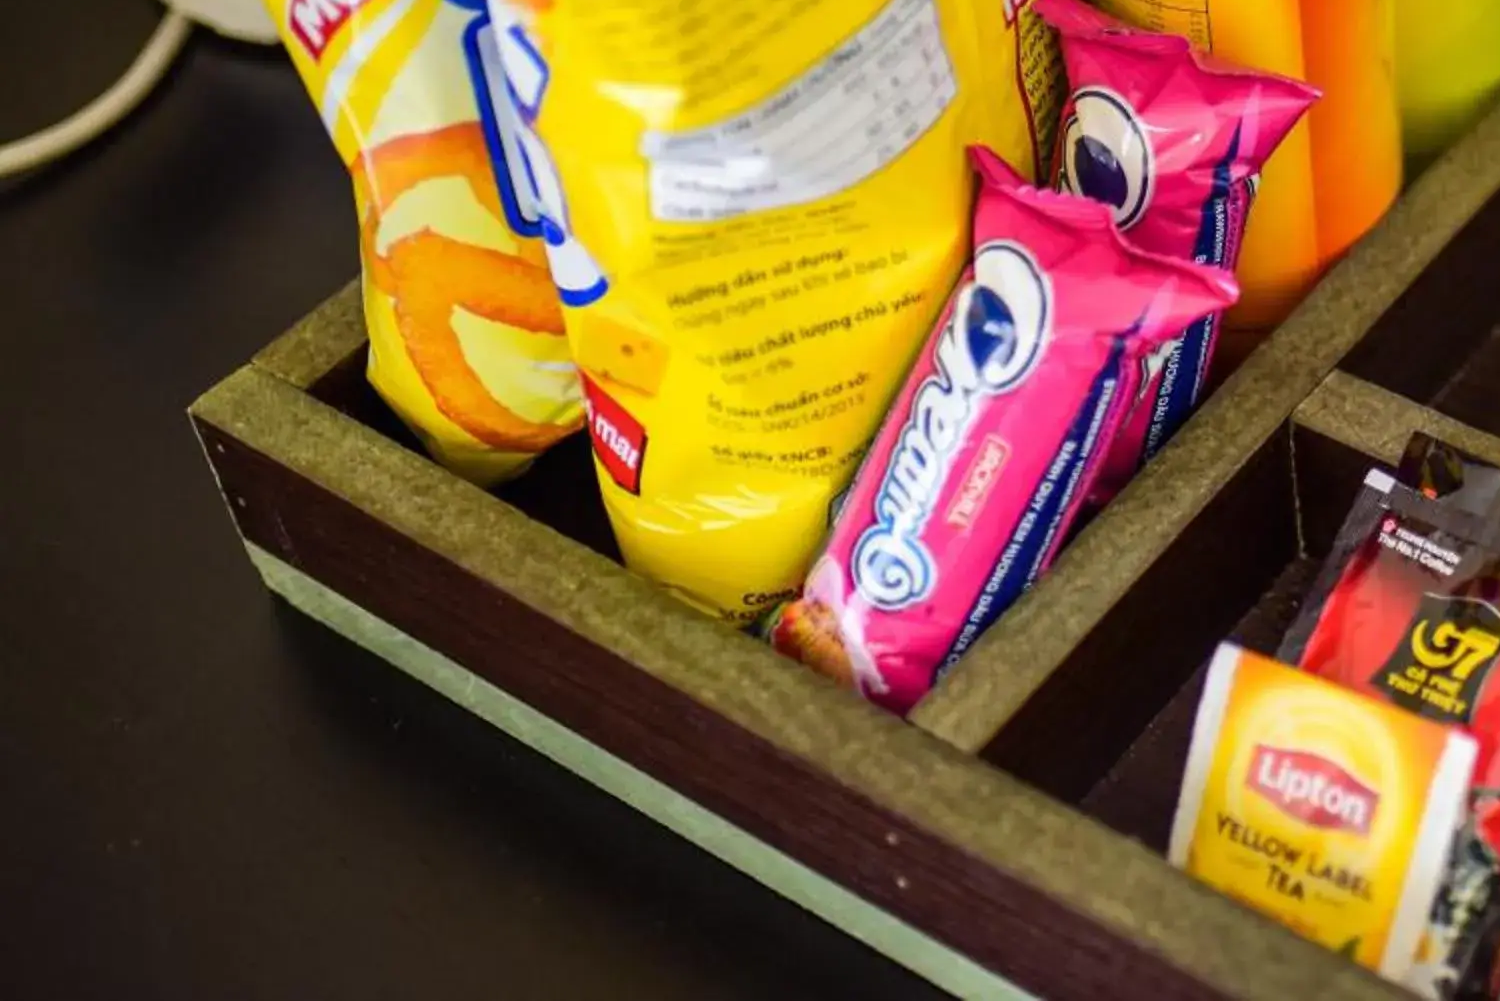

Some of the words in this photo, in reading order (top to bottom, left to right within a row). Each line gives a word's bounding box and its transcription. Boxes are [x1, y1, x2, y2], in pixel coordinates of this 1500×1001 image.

[1257, 750, 1370, 827] Lipton
[1215, 811, 1304, 865] YELLOW
[1306, 852, 1373, 902] LABEL
[1266, 863, 1306, 900] TEA
